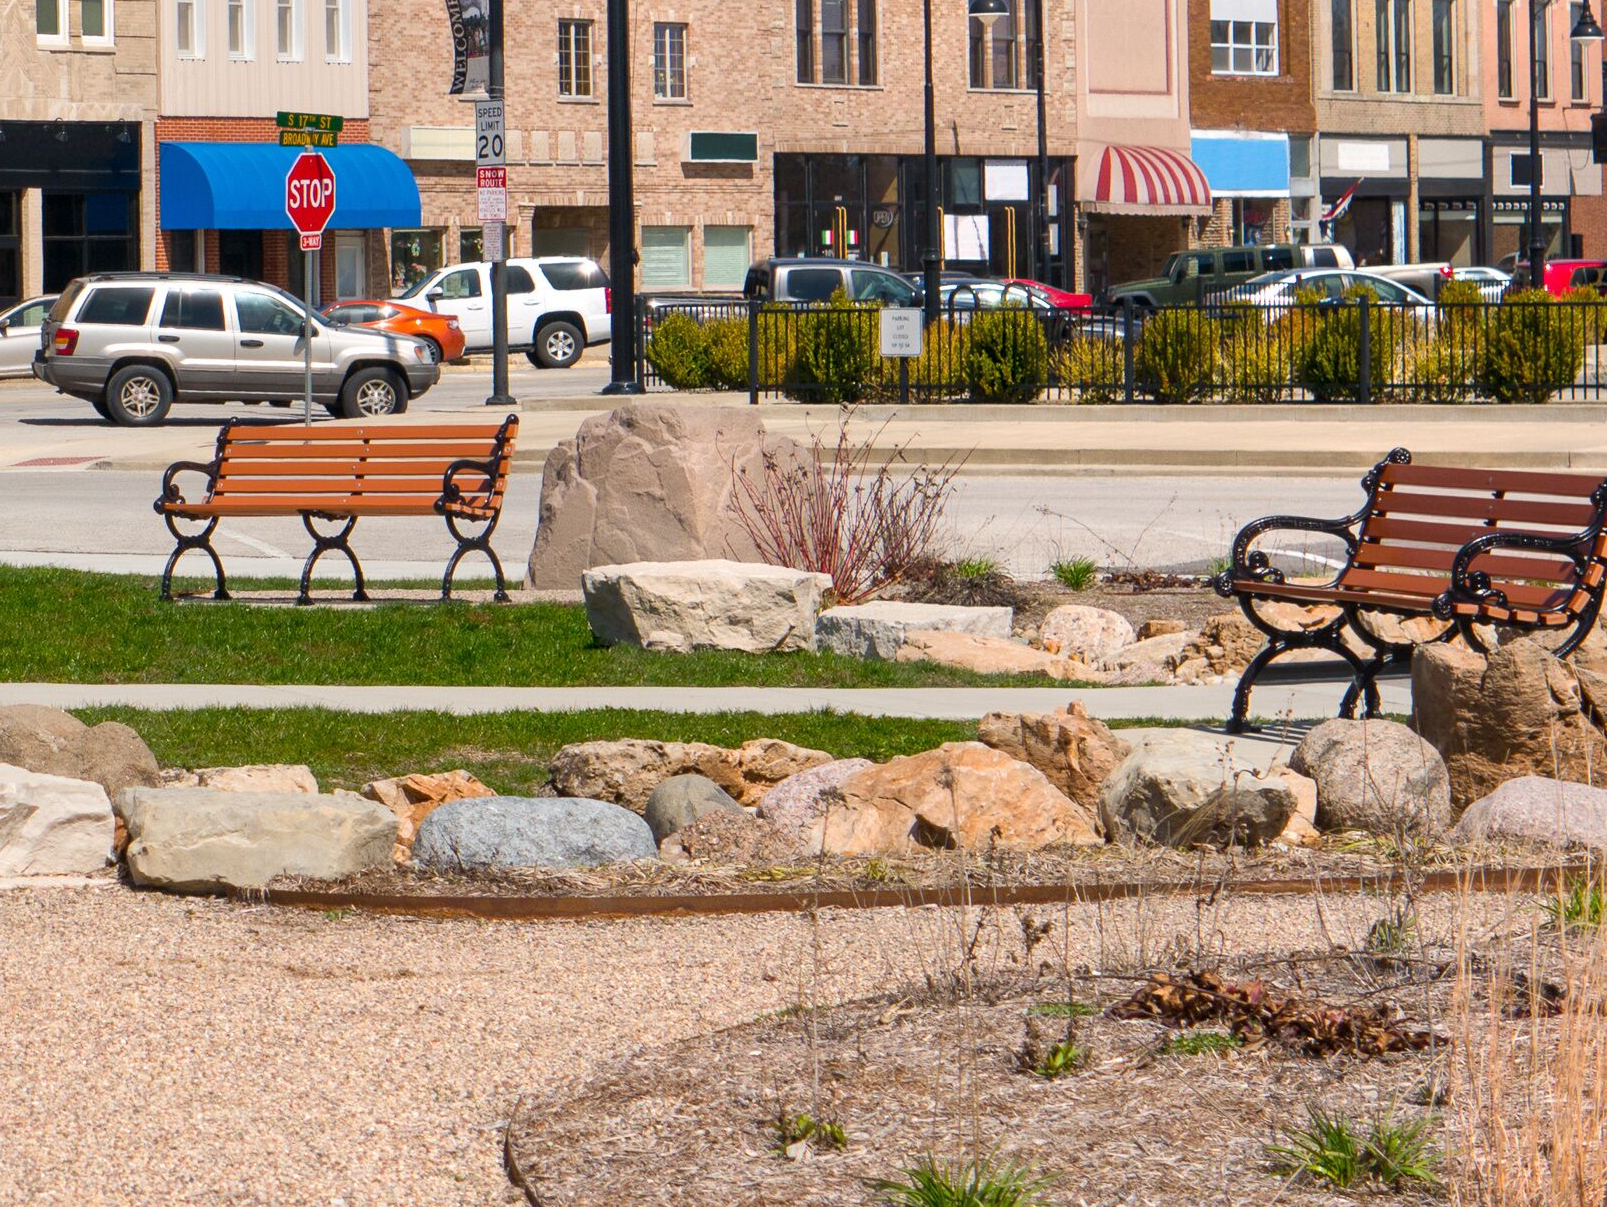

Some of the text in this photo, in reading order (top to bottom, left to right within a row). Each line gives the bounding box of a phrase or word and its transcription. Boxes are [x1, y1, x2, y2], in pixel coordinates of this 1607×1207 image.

[478, 107, 502, 118] SPEED
[288, 114, 294, 126] S
[320, 116, 332, 129] ST
[480, 121, 500, 132] LIMIT
[321, 133, 334, 146] AVE
[479, 134, 503, 159] 20
[479, 170, 504, 179] SNOW
[480, 179, 503, 188] ROUTE
[290, 178, 333, 209] STOP
[302, 236, 320, 247] 3-WAY
